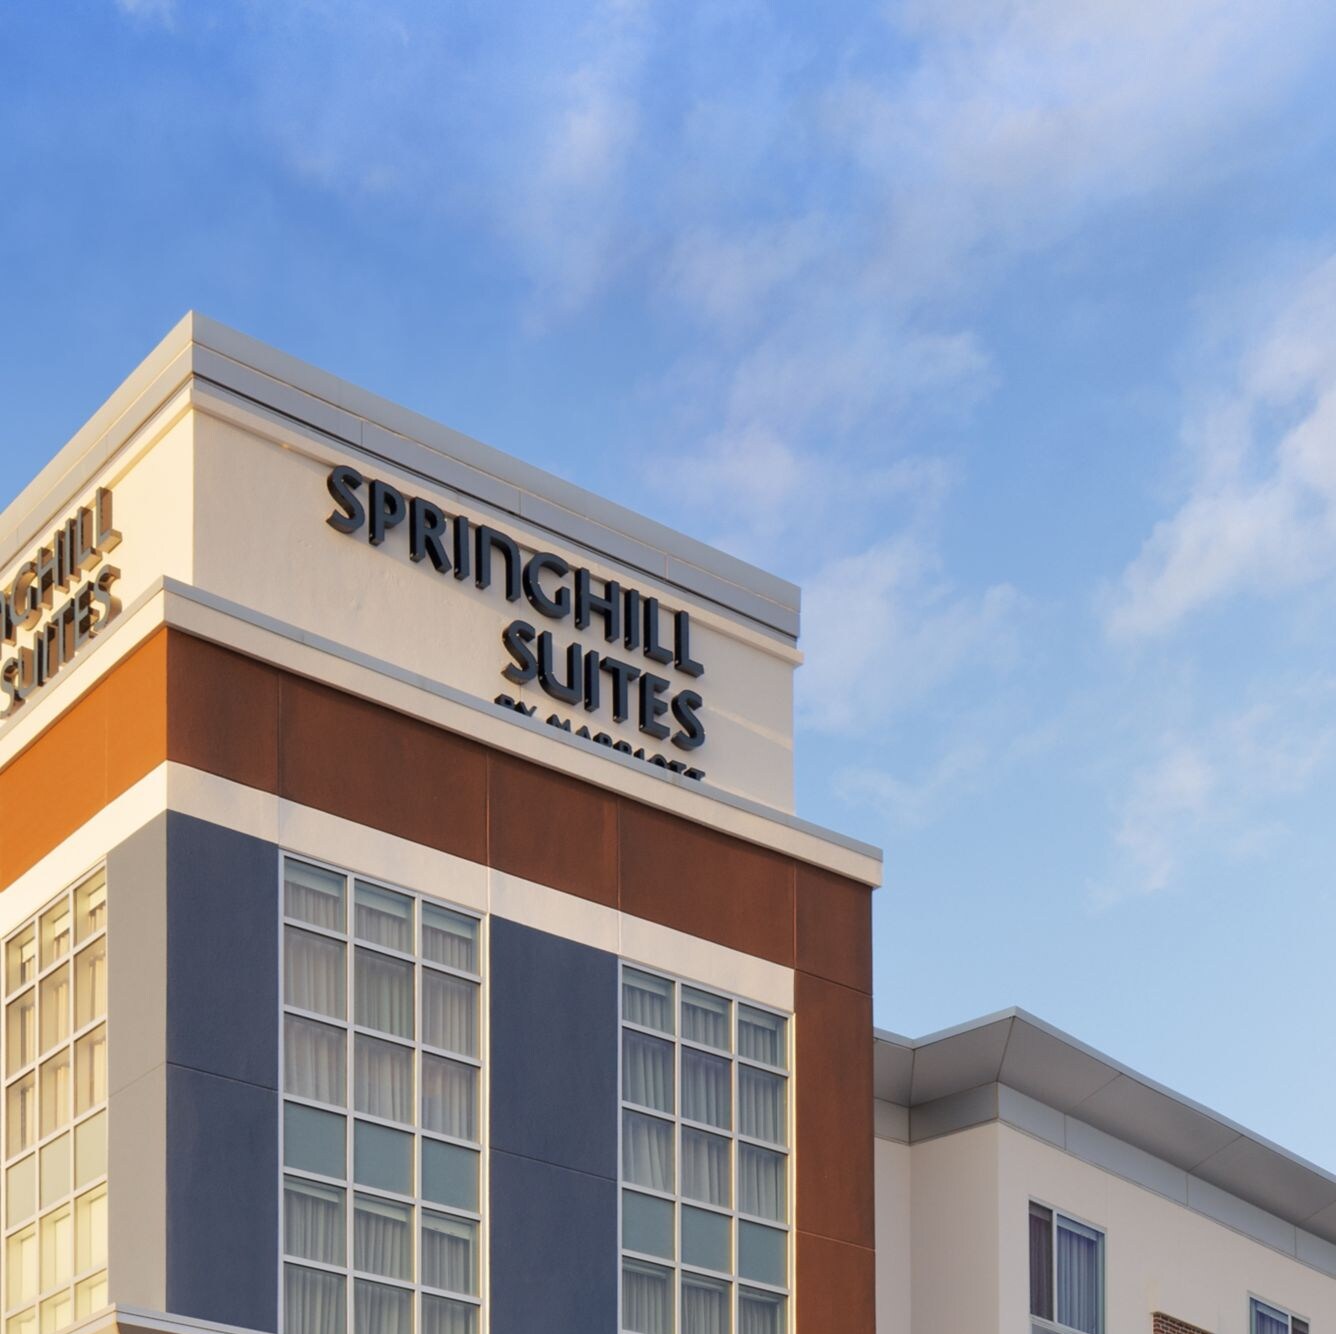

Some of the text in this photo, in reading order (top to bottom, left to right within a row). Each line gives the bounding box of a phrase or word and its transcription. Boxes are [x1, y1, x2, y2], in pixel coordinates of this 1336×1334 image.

[0, 564, 122, 718] SUITES
[326, 465, 705, 678] SPRINGHILL
[501, 619, 706, 751] SUITES
